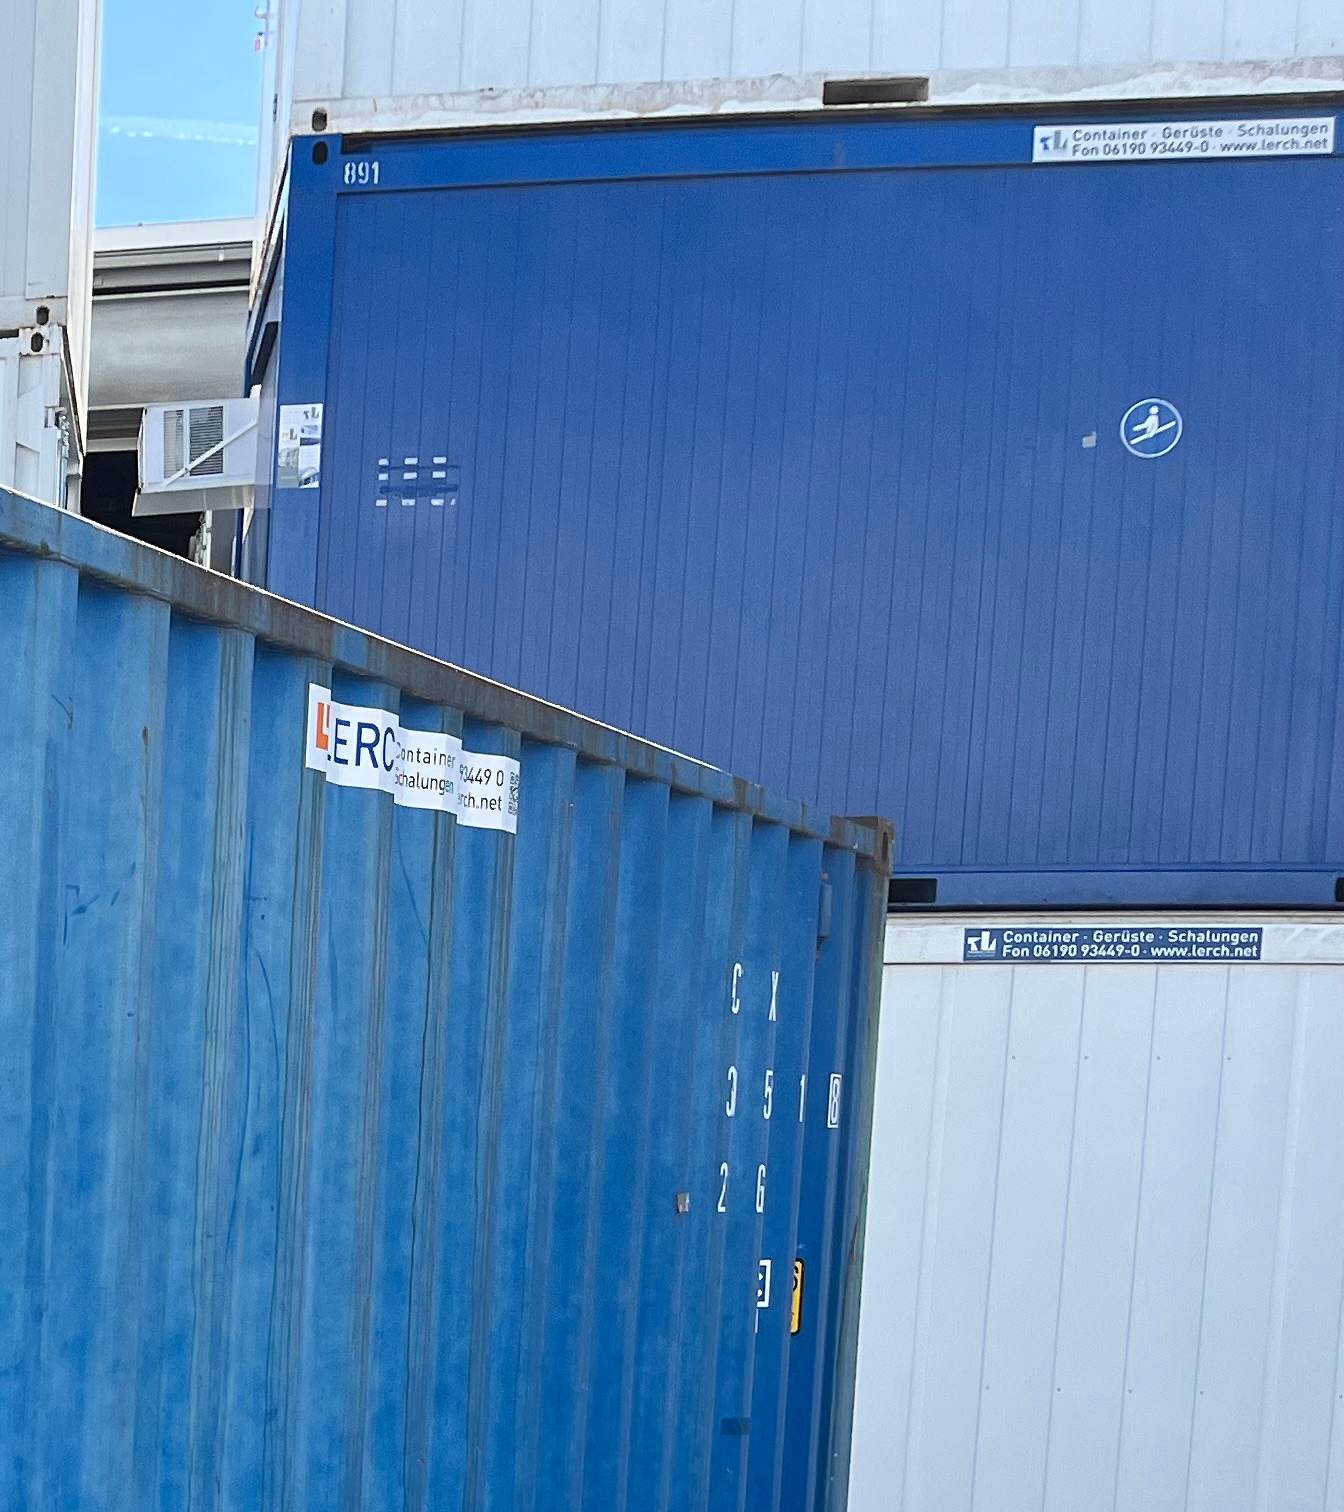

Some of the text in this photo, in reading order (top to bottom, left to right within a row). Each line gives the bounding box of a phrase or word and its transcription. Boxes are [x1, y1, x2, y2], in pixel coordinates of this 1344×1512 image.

[1072, 123, 1329, 142] Container Gerüste Schalungen
[1072, 143, 1099, 157] Fon
[1102, 142, 1147, 156] 06190
[1219, 137, 1329, 152] www.lerch.net
[344, 161, 379, 185] 891
[1003, 929, 1259, 945] Container Gerüste Schalungen
[1002, 943, 1258, 957] Fon 06190 93449-0 www.lerch.net
